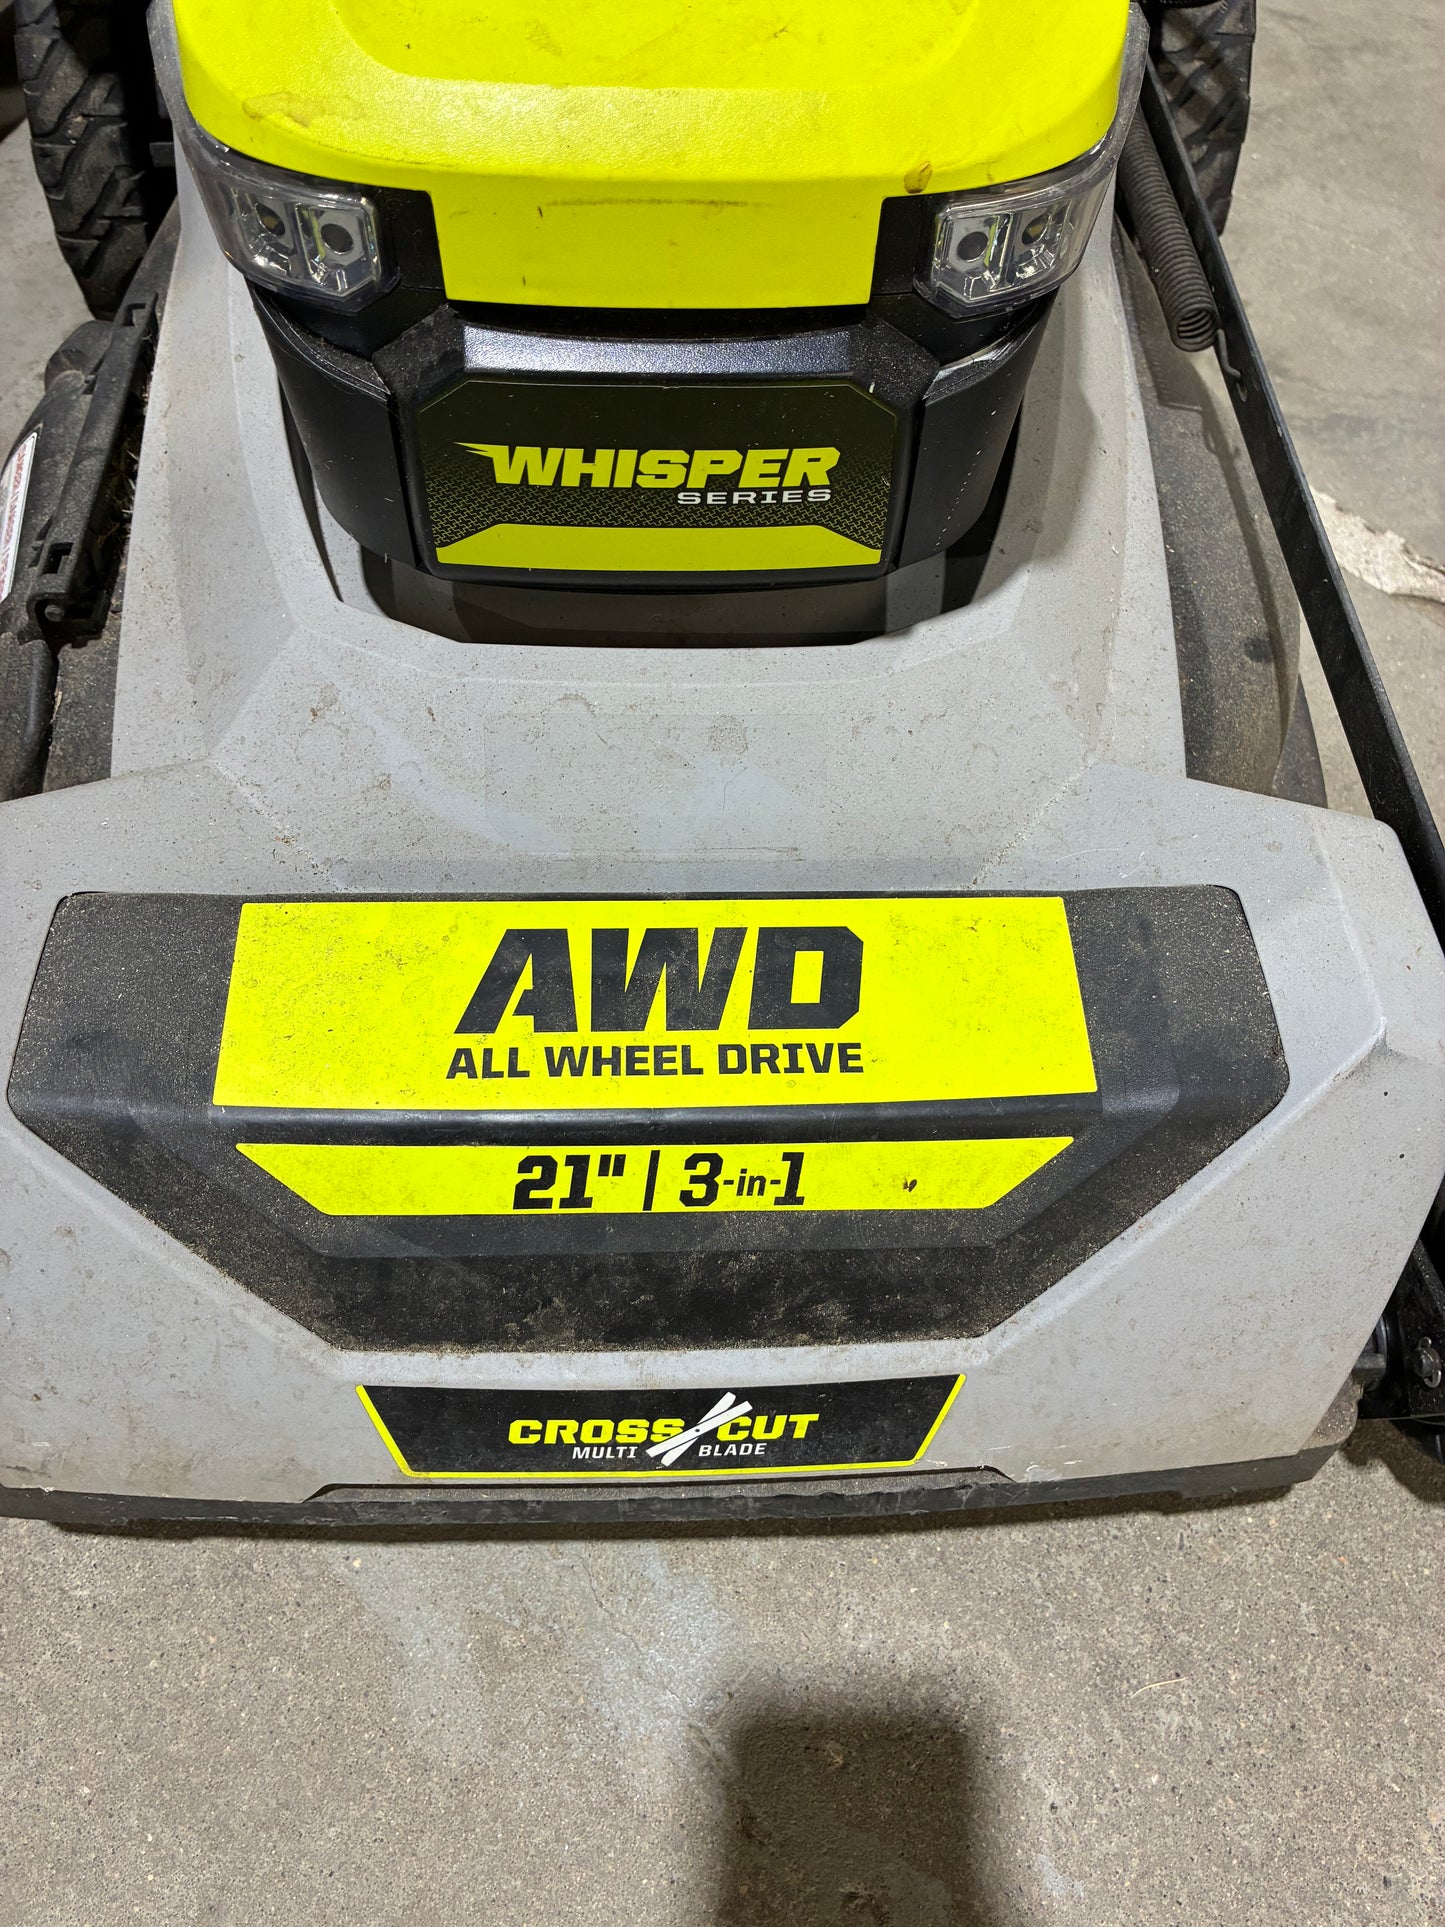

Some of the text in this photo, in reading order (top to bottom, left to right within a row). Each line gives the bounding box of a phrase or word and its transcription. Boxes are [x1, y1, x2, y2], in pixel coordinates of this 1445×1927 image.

[455, 442, 841, 488] WHISPER
[677, 488, 832, 505] SERIES
[454, 926, 864, 1034] AWD
[446, 1042, 864, 1079] ALL WHEEL DRIVE
[512, 1154, 626, 1210] 21"
[679, 1151, 805, 1207] 3-in-1
[508, 1413, 820, 1444] CROSS CUT
[573, 1442, 767, 1460] MULTI BLADE
